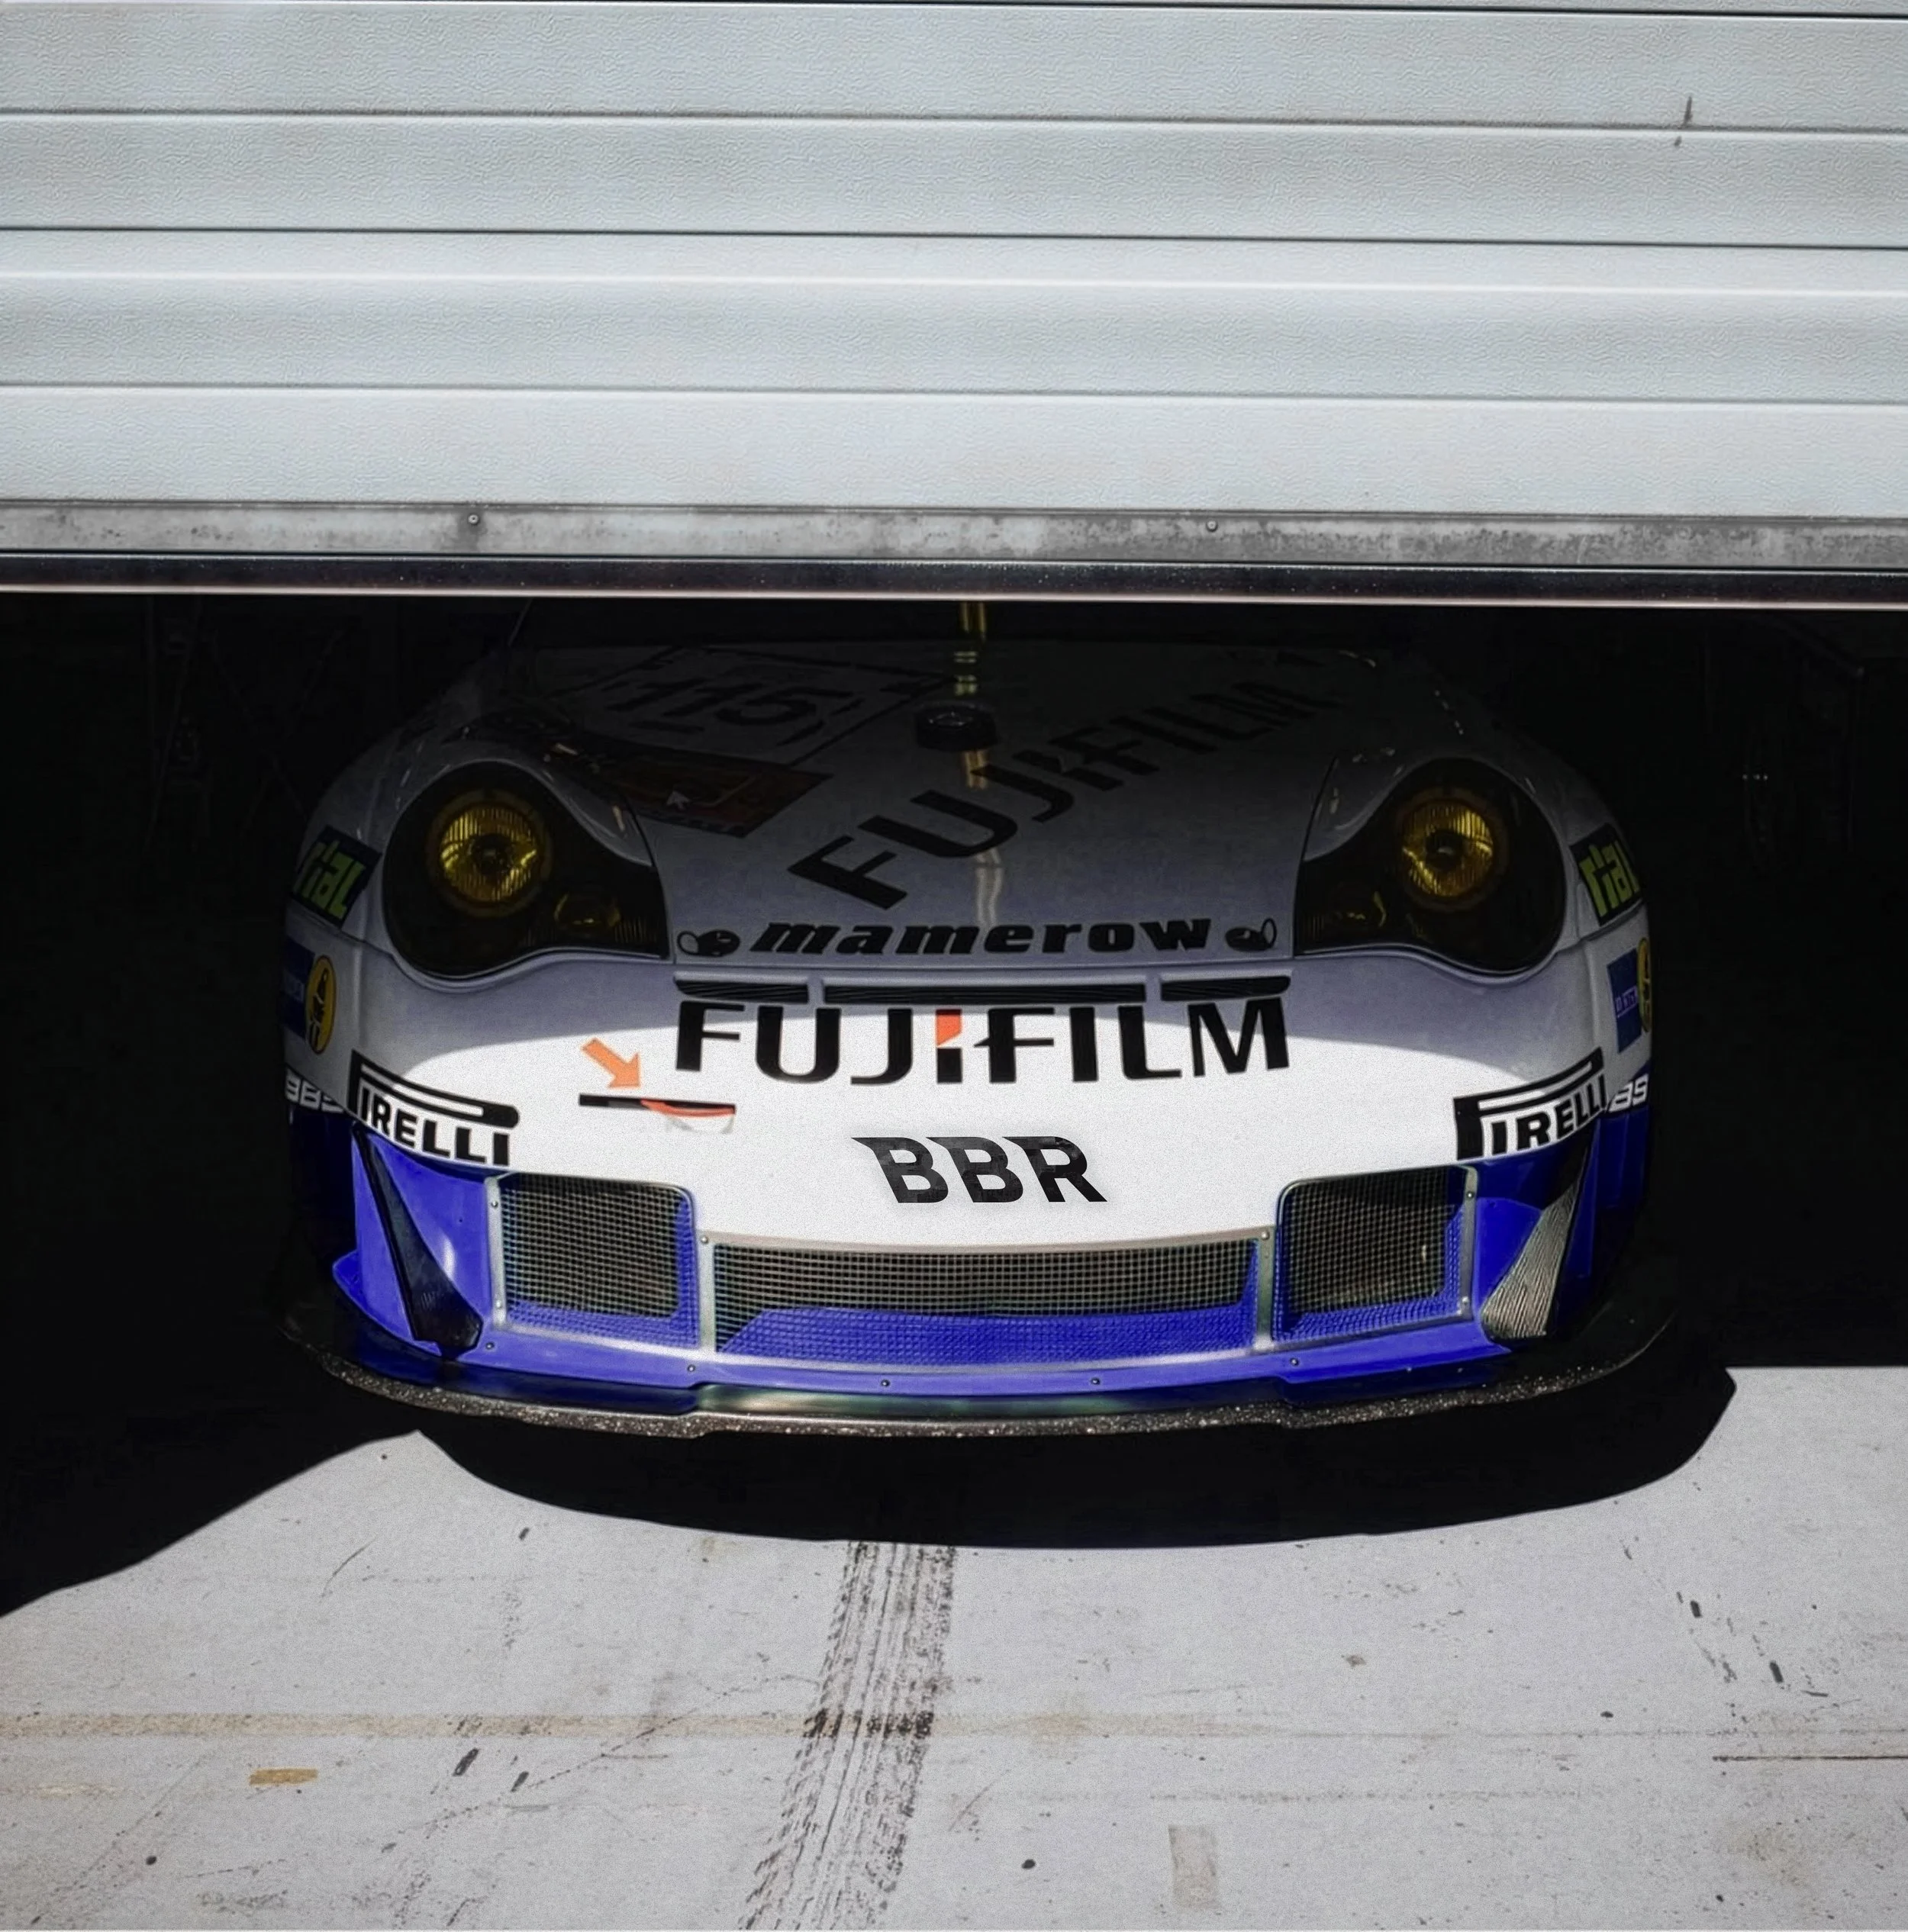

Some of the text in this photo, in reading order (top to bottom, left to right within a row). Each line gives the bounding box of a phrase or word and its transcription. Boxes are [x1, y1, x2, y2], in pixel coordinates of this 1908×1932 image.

[788, 681, 1341, 910] FUJIFILM
[749, 918, 1212, 956] mamerow
[675, 997, 1290, 1085] FUJIFILM
[347, 1049, 519, 1166] PIRELLI
[1454, 1047, 1607, 1161] PIRELLI
[852, 1136, 1107, 1203] BBR
